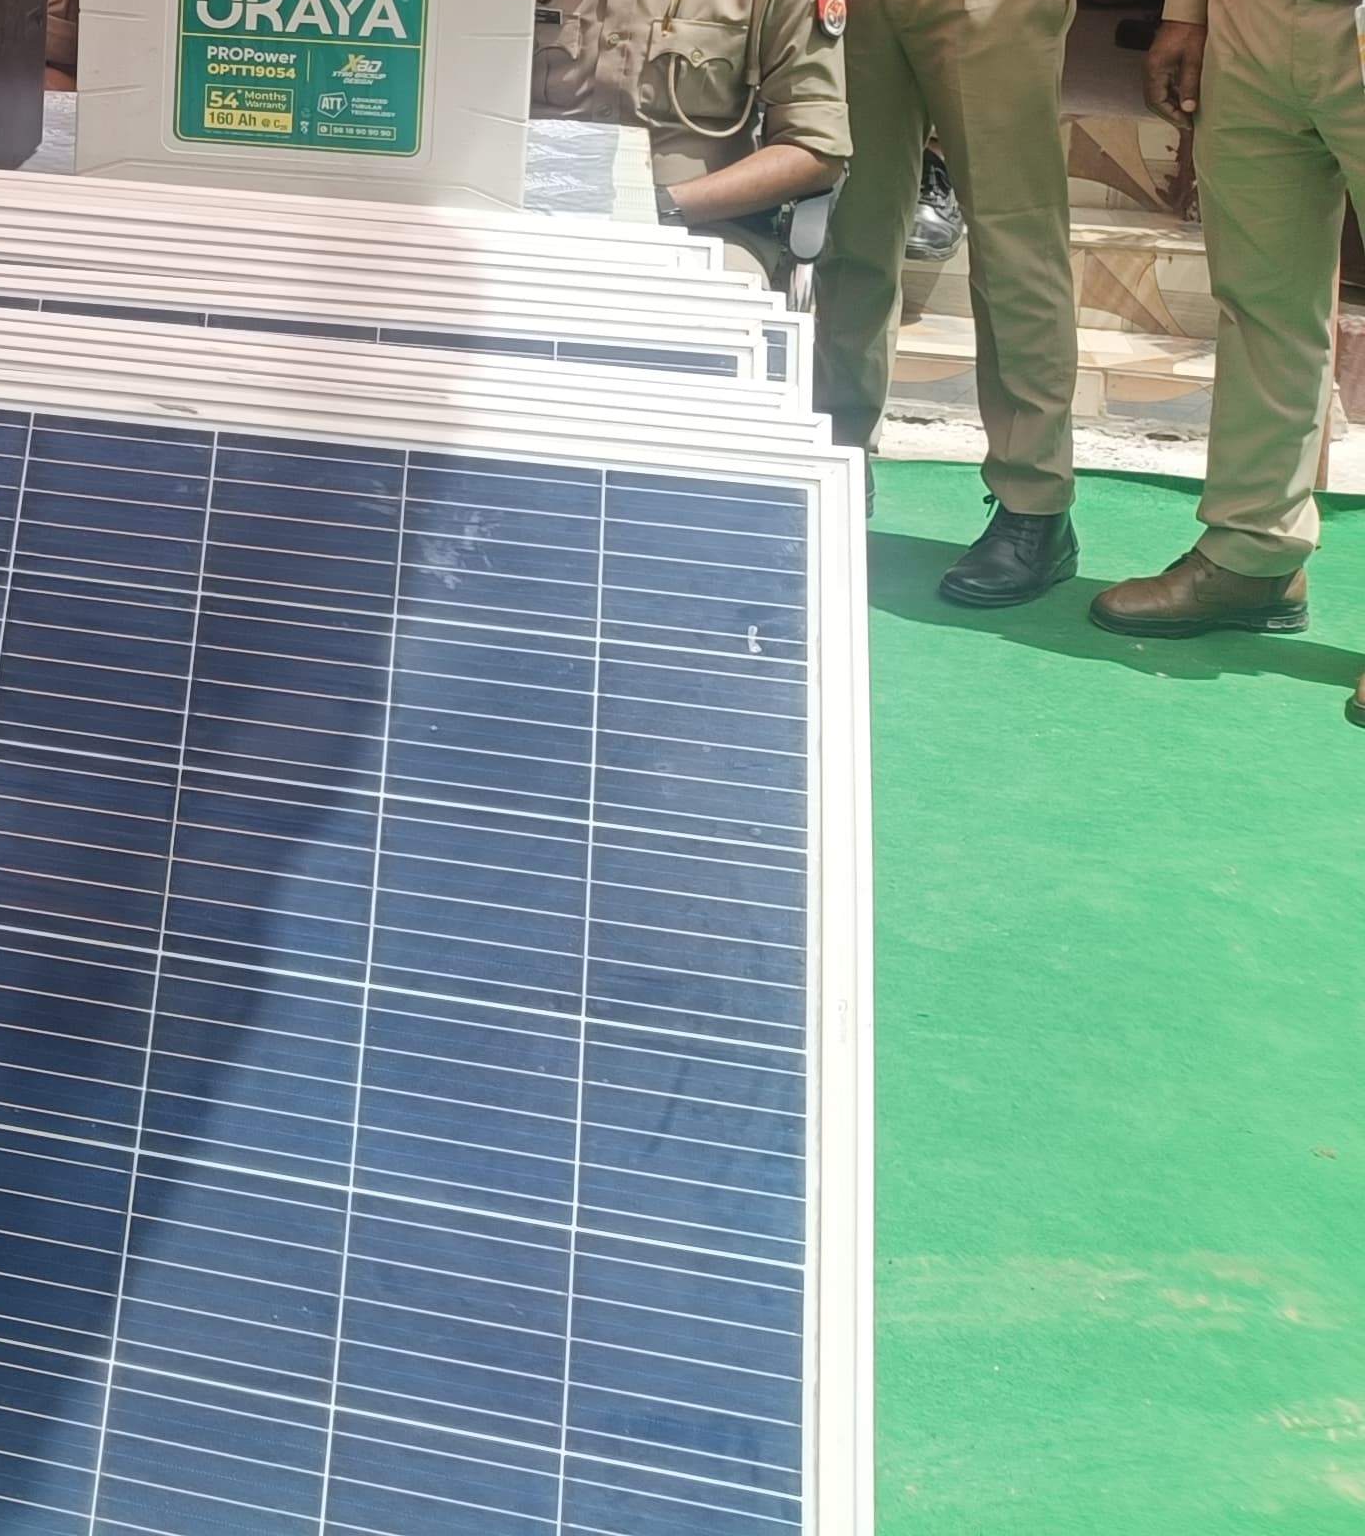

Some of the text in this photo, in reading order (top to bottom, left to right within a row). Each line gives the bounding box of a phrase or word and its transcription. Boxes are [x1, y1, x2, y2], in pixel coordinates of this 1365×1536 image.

[207, 45, 297, 64] PROPower
[207, 63, 297, 79] OPTT19054
[244, 90, 287, 102] Months
[244, 99, 287, 111] Warranty
[321, 97, 343, 110] ATT
[209, 111, 234, 125] 160
[238, 113, 257, 127] Ah
